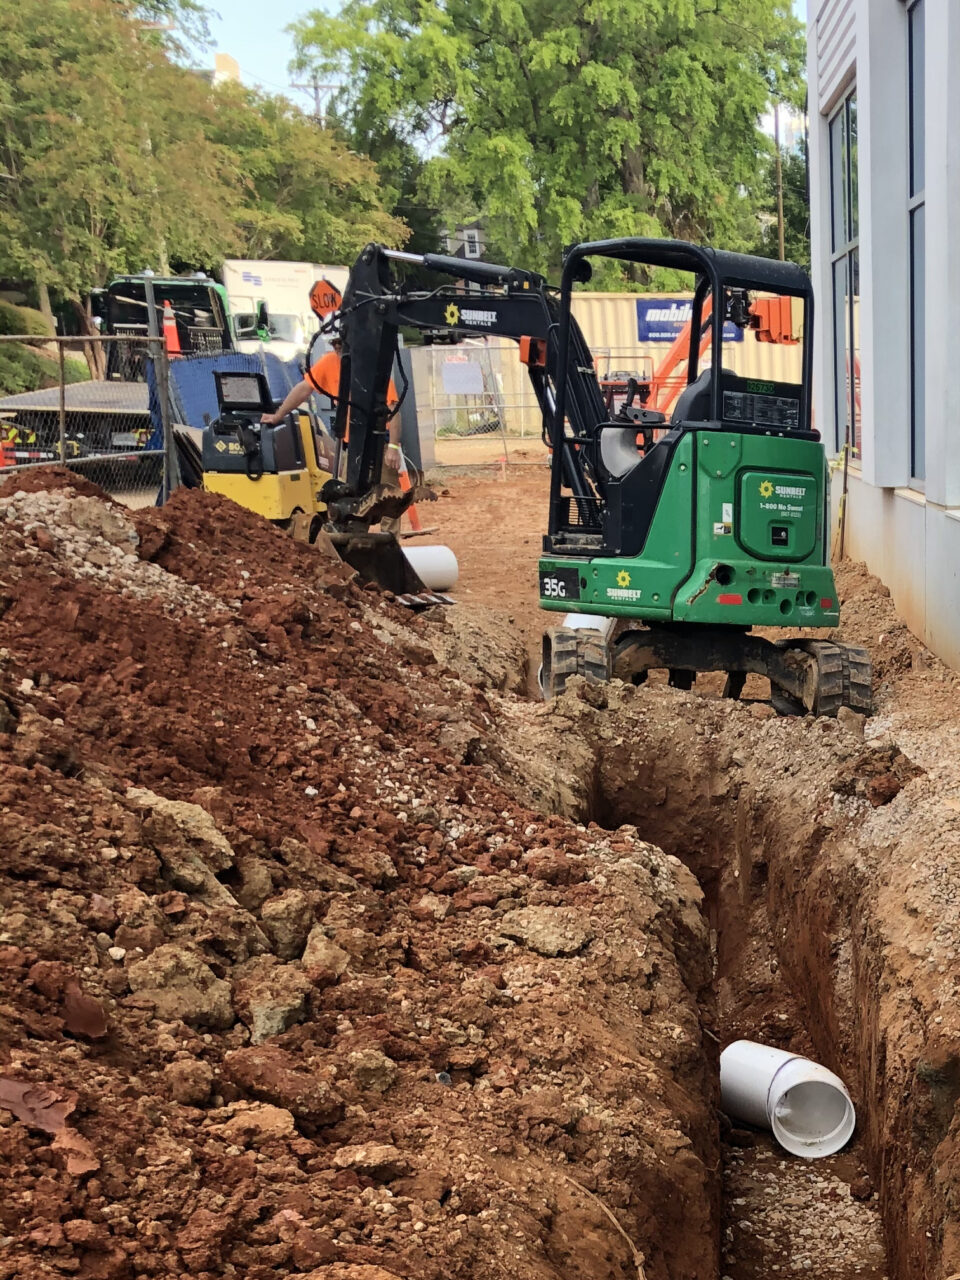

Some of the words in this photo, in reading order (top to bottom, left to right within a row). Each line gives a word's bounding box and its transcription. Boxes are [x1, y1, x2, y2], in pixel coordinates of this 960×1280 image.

[312, 293, 338, 309] SLOW
[461, 309, 498, 322] SUNBELT
[775, 485, 806, 496] SUNBELT
[760, 502, 777, 510] 1-800
[544, 577, 566, 597] 35G
[606, 587, 642, 598] SUNBELT
